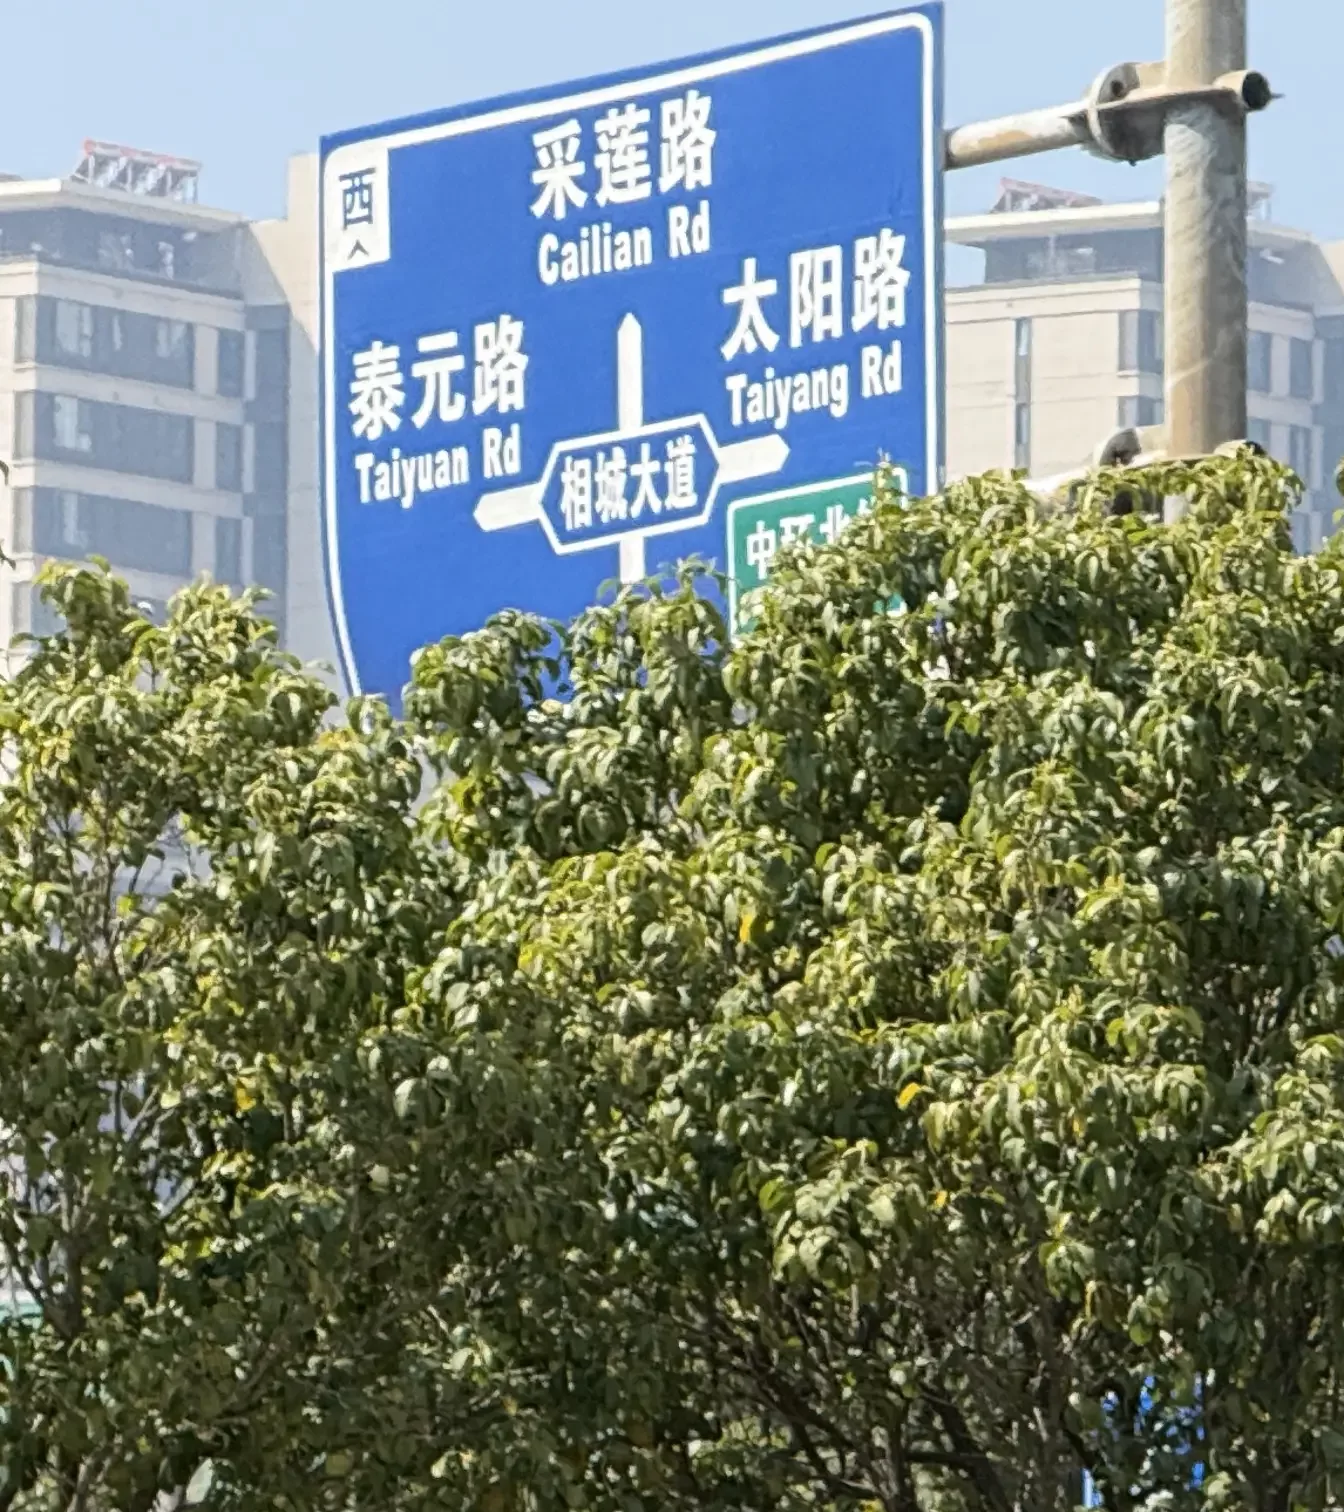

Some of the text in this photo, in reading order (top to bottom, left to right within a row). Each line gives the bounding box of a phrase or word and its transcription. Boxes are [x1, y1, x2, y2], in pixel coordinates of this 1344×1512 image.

[340, 167, 377, 229] 西
[530, 90, 716, 219] 采莲路
[538, 201, 710, 284] Cailian Rd
[721, 228, 910, 360] 太阳路
[349, 314, 529, 440] 泰元路
[726, 340, 902, 429] Taiyang Rd
[355, 424, 520, 509] Taiyuan Rd
[560, 435, 697, 530] 相城大道
